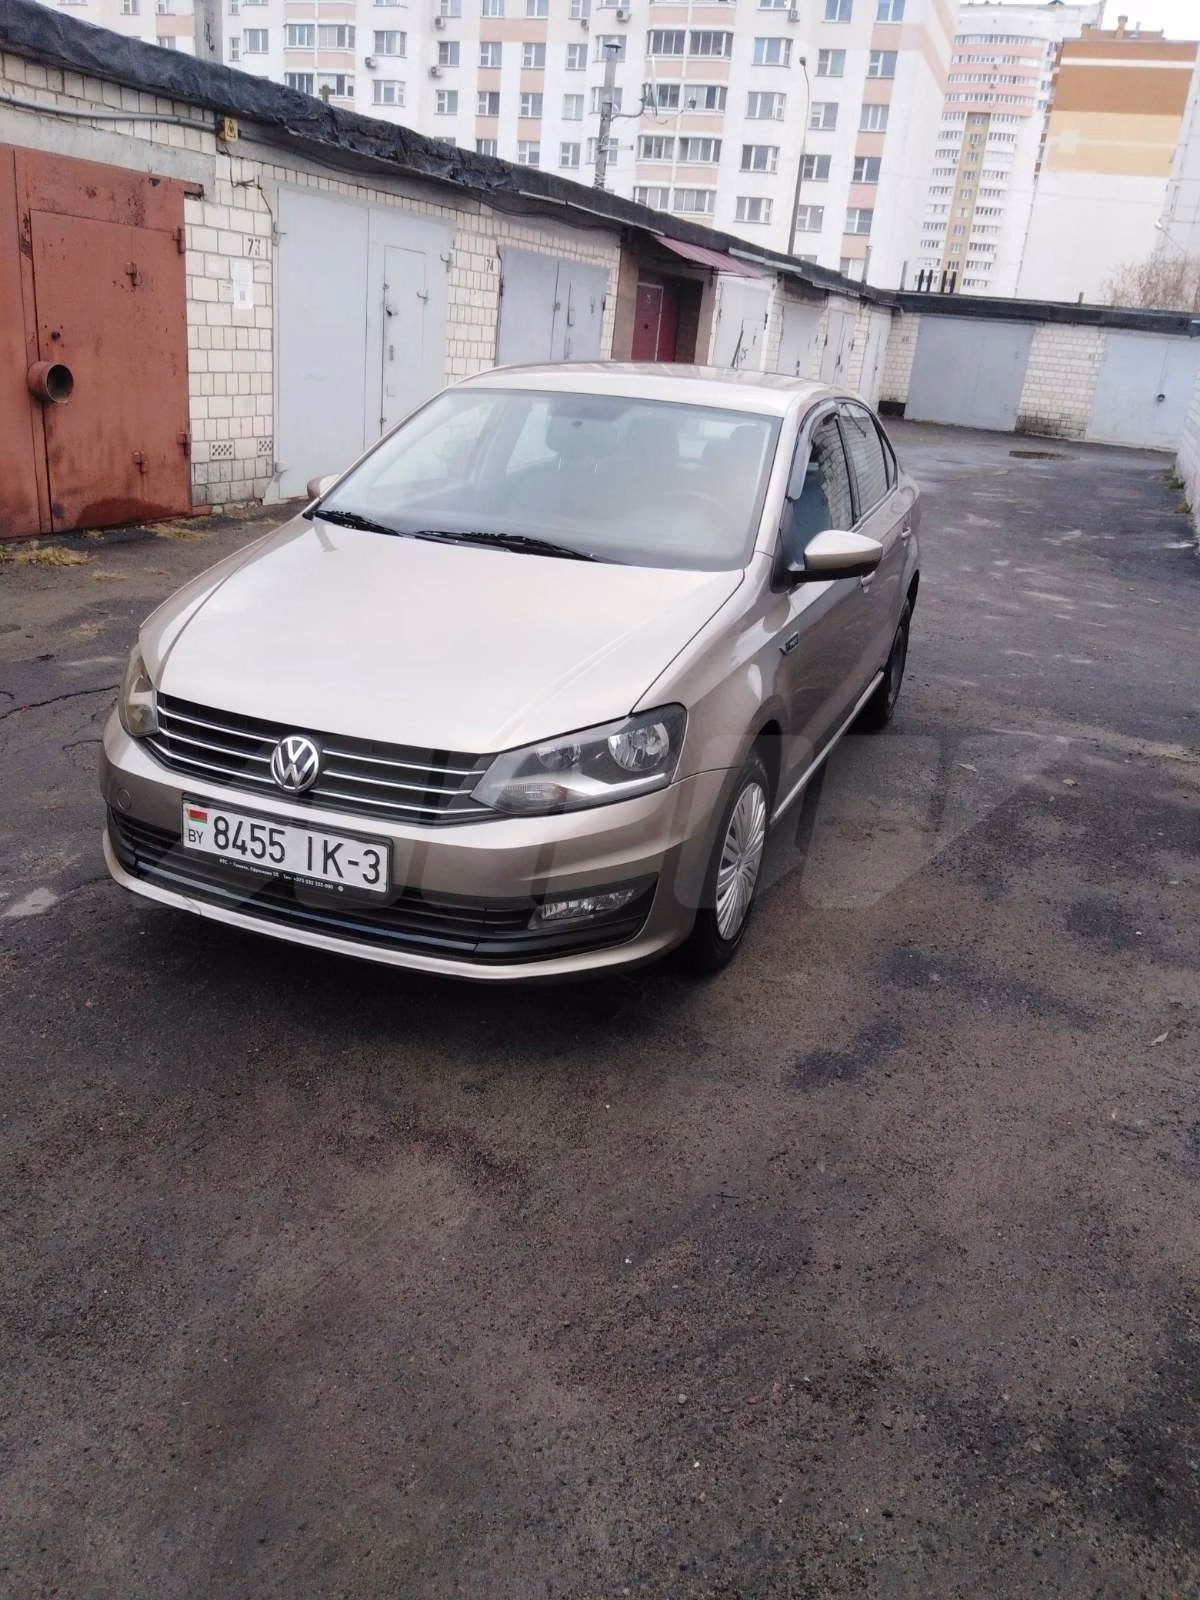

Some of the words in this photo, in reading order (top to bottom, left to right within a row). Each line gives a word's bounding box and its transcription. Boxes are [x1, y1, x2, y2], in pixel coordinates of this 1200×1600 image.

[247, 238, 261, 256] 73
[188, 828, 204, 845] BY
[213, 815, 286, 864] 8455
[307, 836, 381, 885] IK-3
